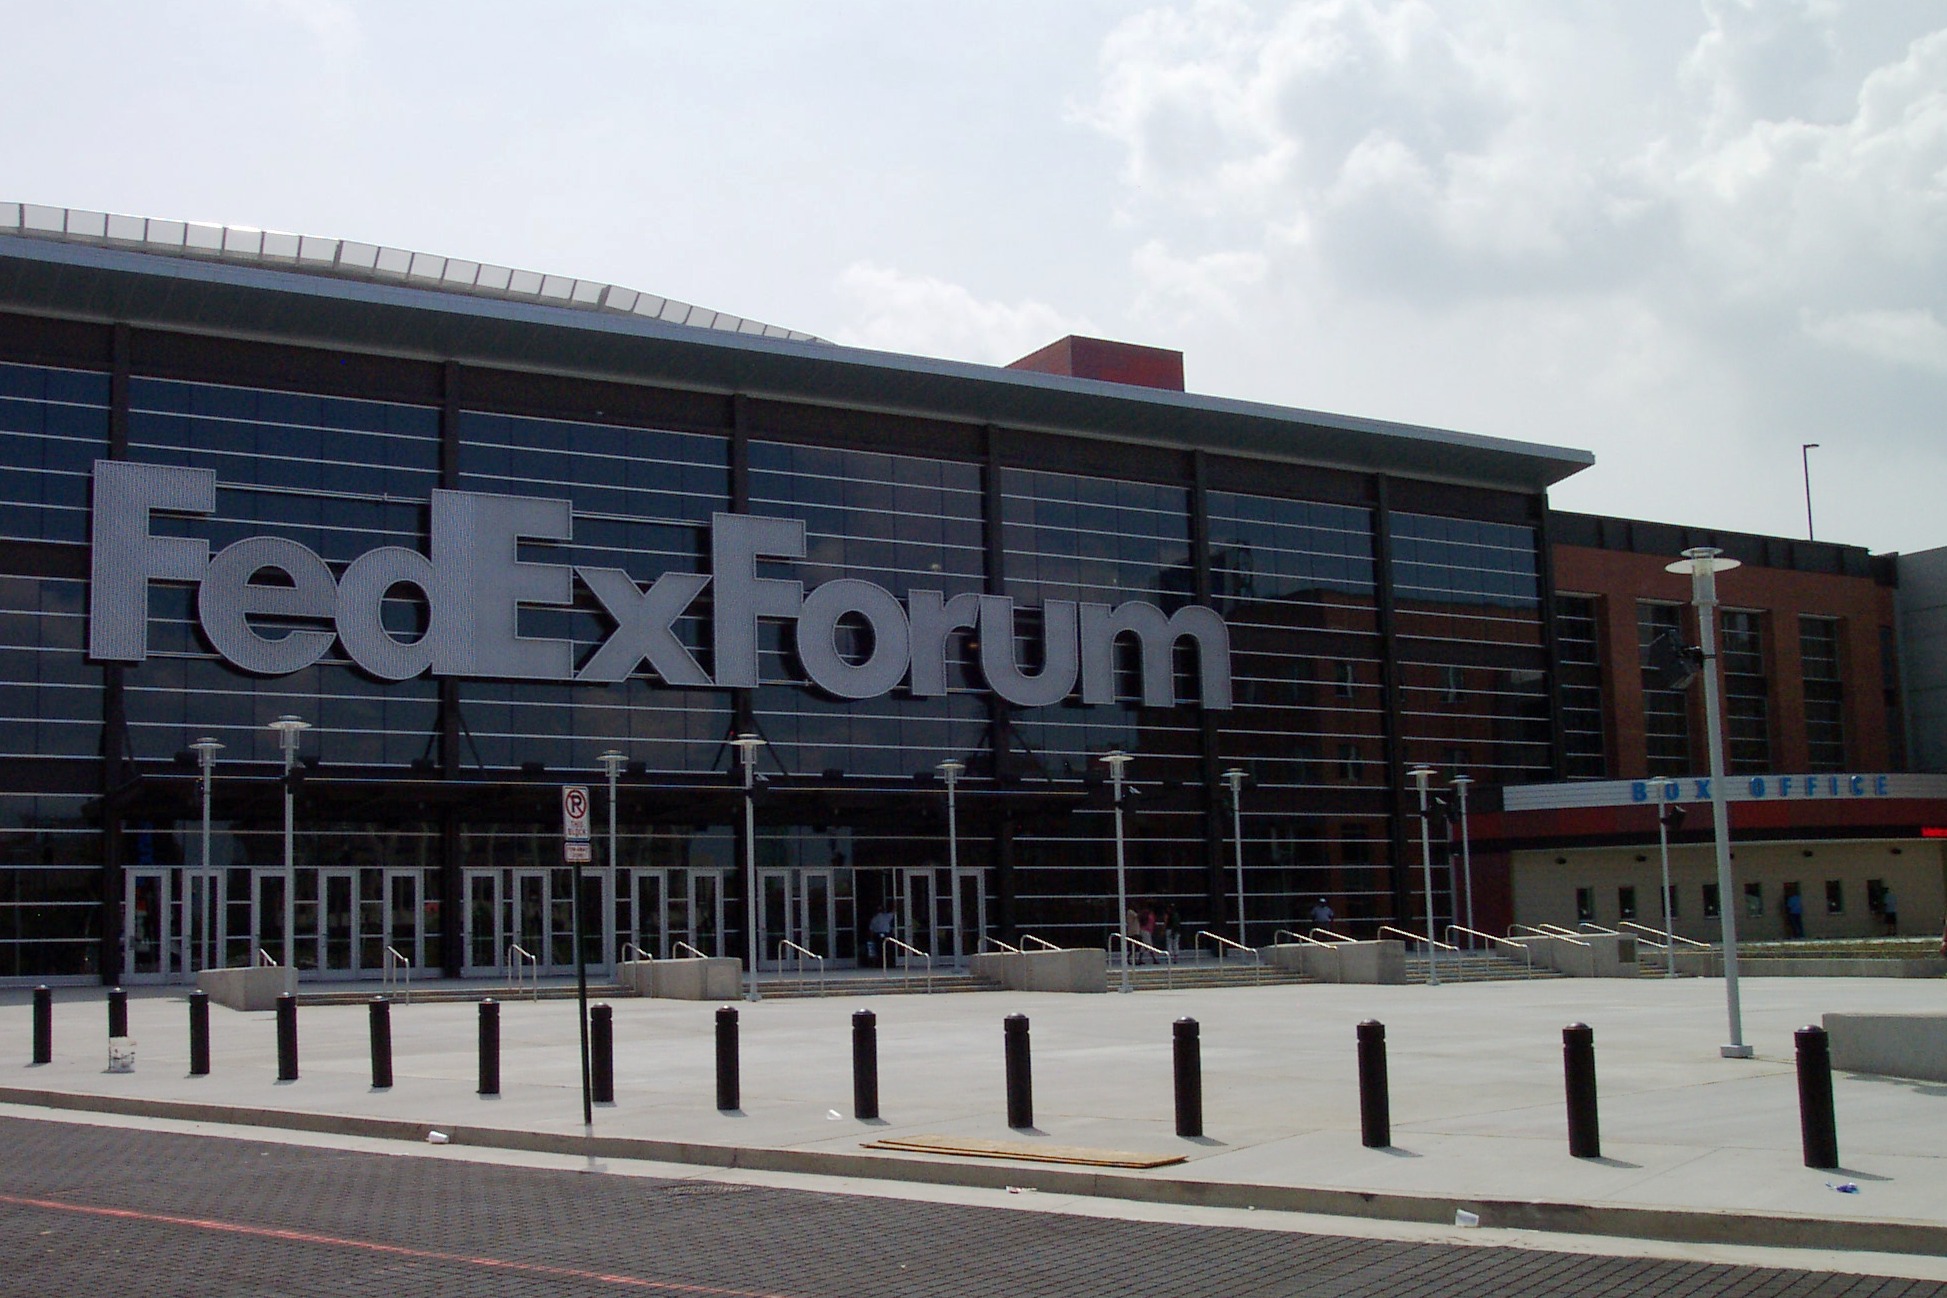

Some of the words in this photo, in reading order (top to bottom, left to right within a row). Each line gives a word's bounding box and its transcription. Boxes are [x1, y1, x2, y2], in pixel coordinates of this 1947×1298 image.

[90, 459, 1232, 710] FedExForum
[1631, 779, 1712, 802] BOX
[1750, 775, 1888, 799] OFFICE
